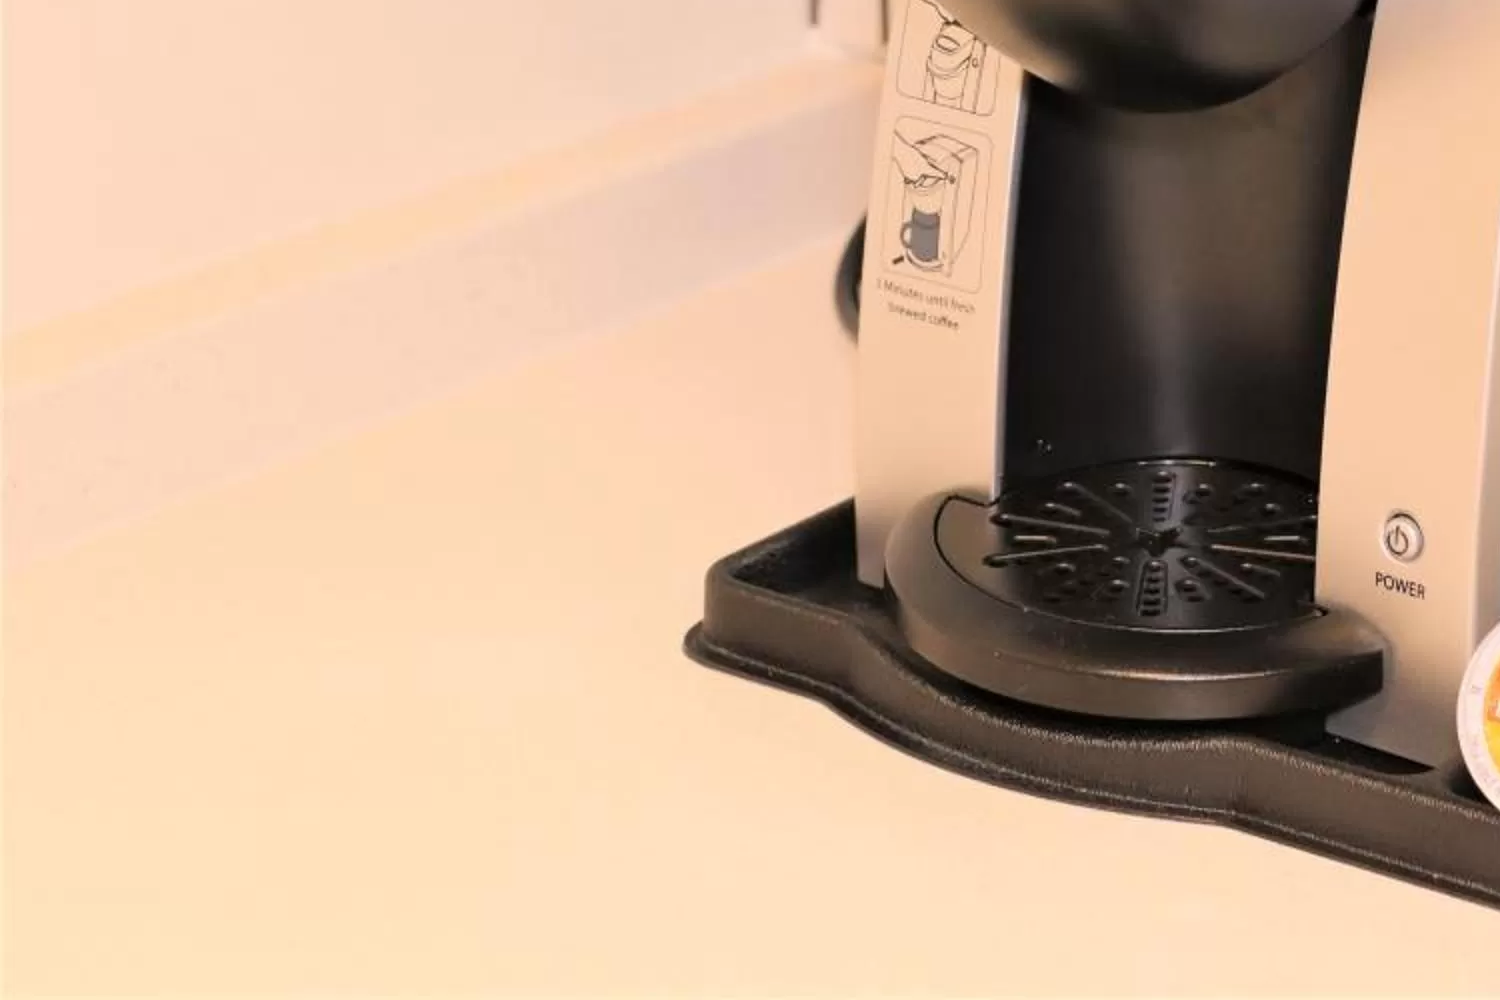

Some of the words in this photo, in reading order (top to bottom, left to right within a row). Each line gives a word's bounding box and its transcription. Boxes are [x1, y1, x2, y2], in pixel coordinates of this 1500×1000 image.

[887, 301, 927, 322] brewed
[927, 314, 960, 331] coffee
[1375, 571, 1426, 600] POWER
